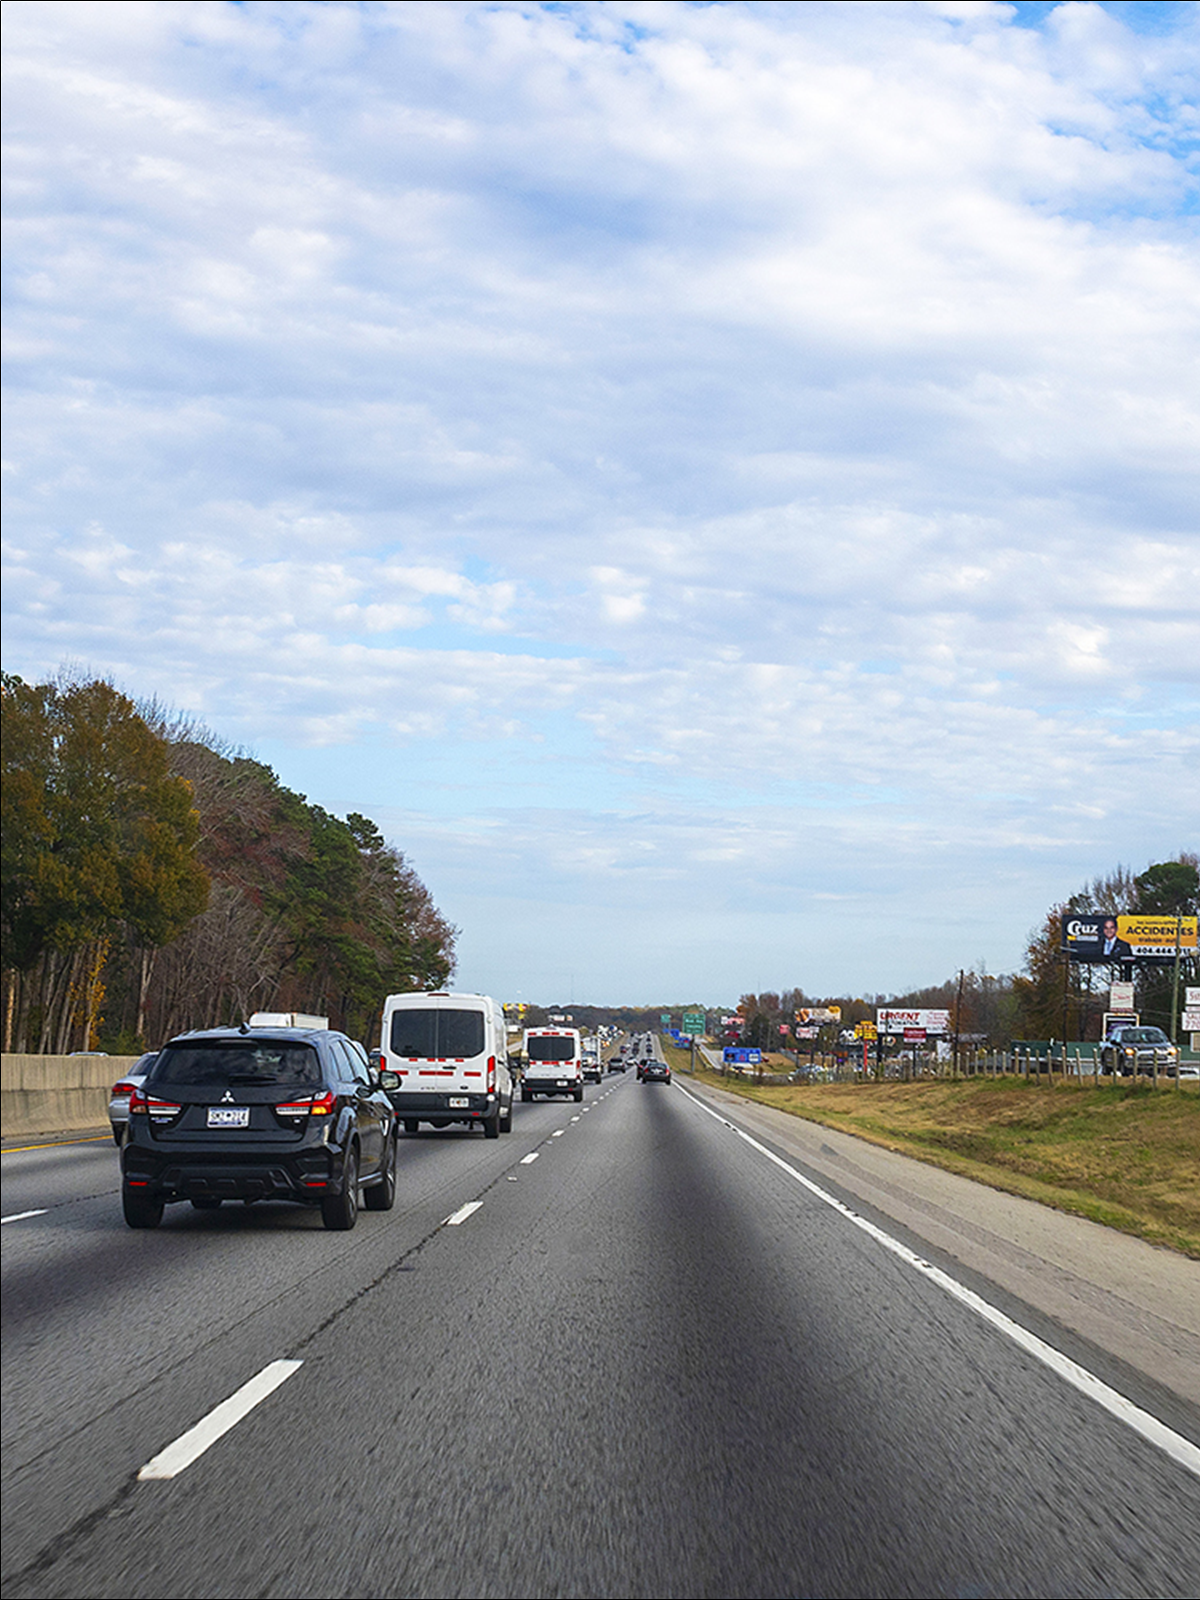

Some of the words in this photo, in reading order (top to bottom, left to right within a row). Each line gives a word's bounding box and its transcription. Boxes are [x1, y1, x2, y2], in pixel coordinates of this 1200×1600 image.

[1066, 920, 1098, 936] Cruz
[1126, 926, 1194, 936] ACCIDENTES
[880, 1011, 920, 1020] URGENT
